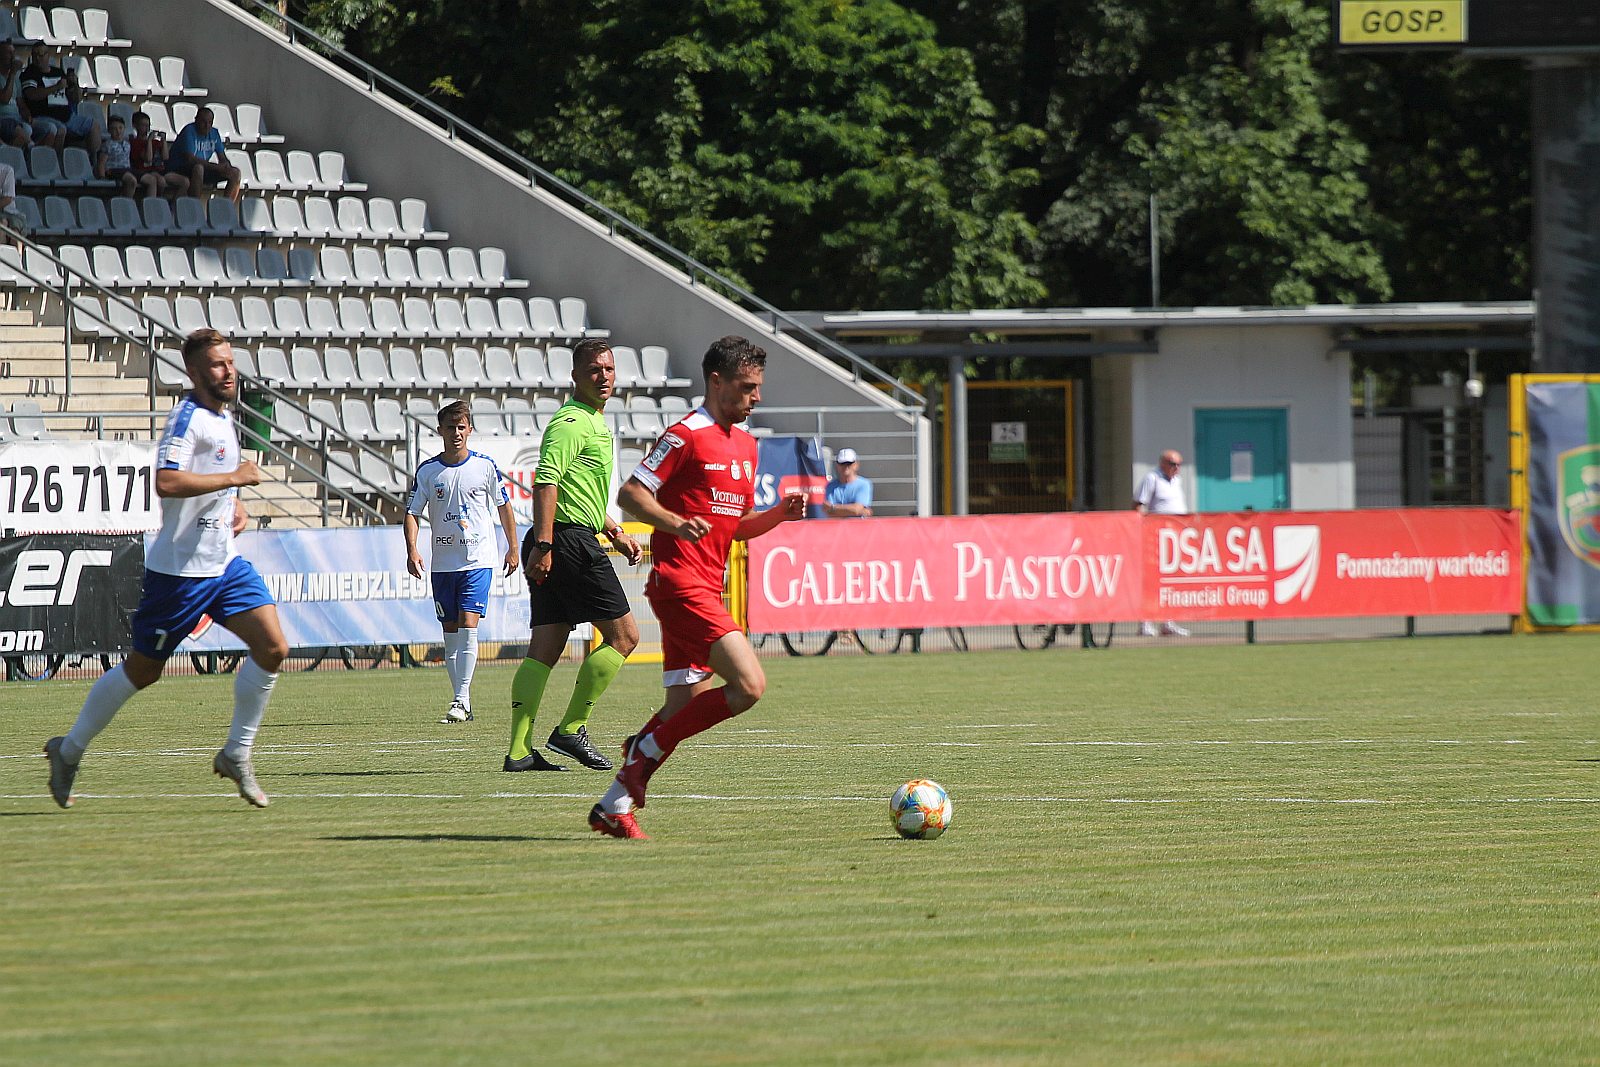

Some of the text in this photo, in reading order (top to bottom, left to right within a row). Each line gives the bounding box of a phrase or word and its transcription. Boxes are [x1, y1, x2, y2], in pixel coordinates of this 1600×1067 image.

[1362, 10, 1445, 33] GOSP.
[0, 465, 63, 513] 726
[197, 517, 220, 530] PEC
[436, 536, 453, 545] PEC
[1159, 526, 1268, 574] DSA SA
[0, 549, 113, 606] er
[762, 537, 1124, 608] GALERIA PIASTÓW
[1336, 550, 1510, 583] Pomnażamy wartości
[1159, 585, 1269, 610] Financial Group
[155, 628, 168, 651] 7
